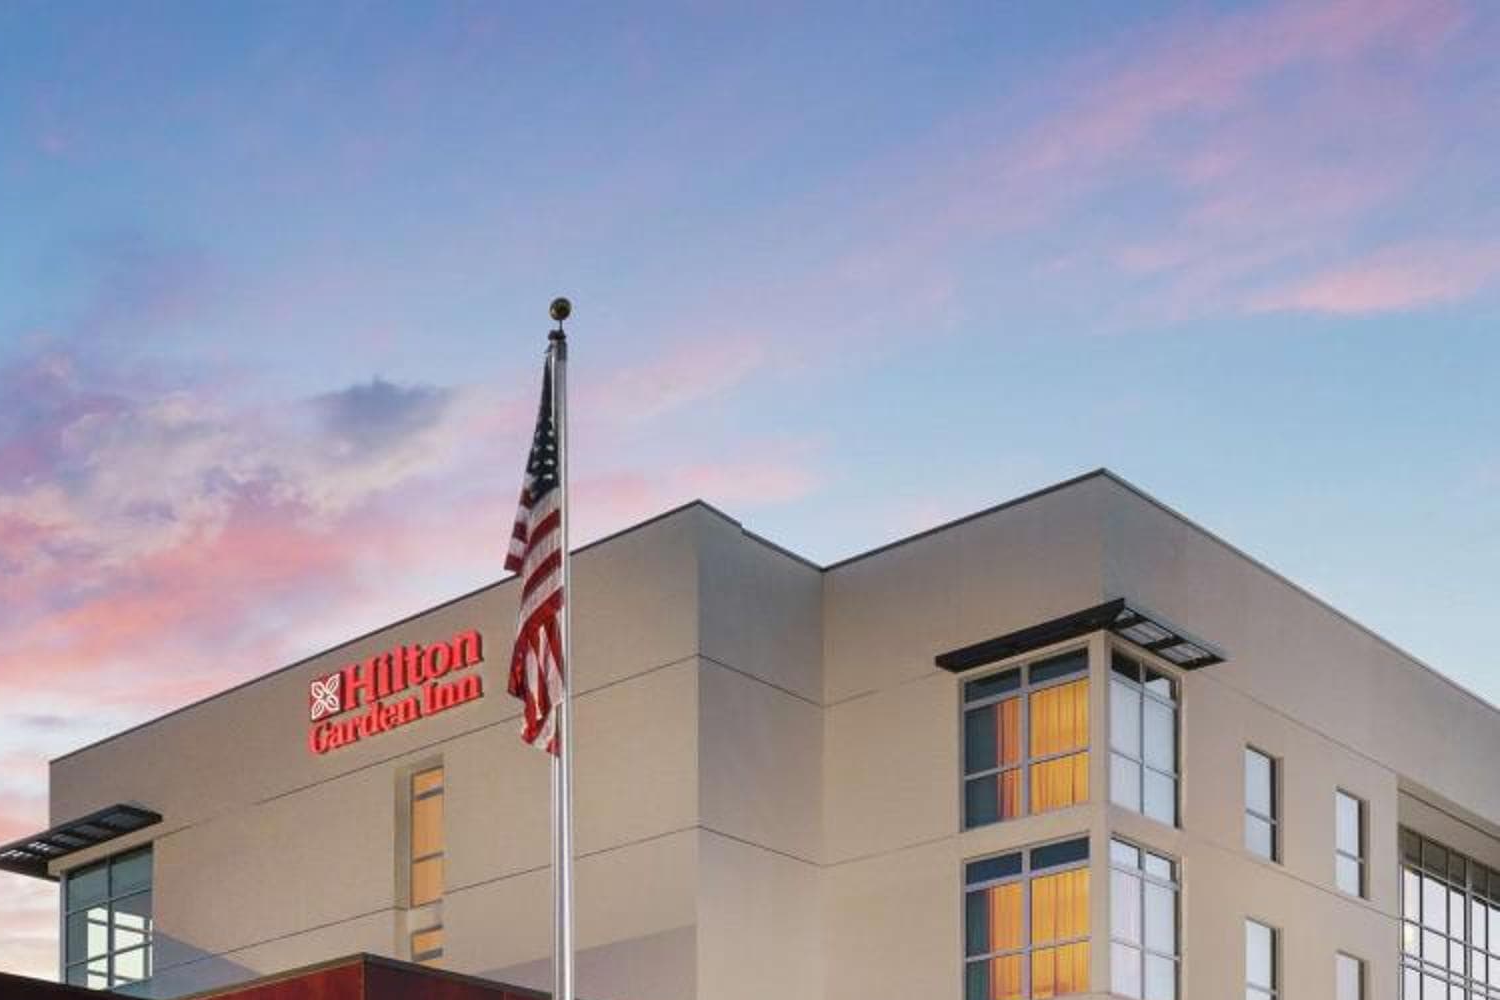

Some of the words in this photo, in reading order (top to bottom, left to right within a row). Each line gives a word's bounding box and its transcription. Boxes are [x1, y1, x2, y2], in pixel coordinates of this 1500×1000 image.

[341, 629, 483, 711] Hilton
[309, 694, 422, 754] Garden
[421, 674, 483, 715] Inn
